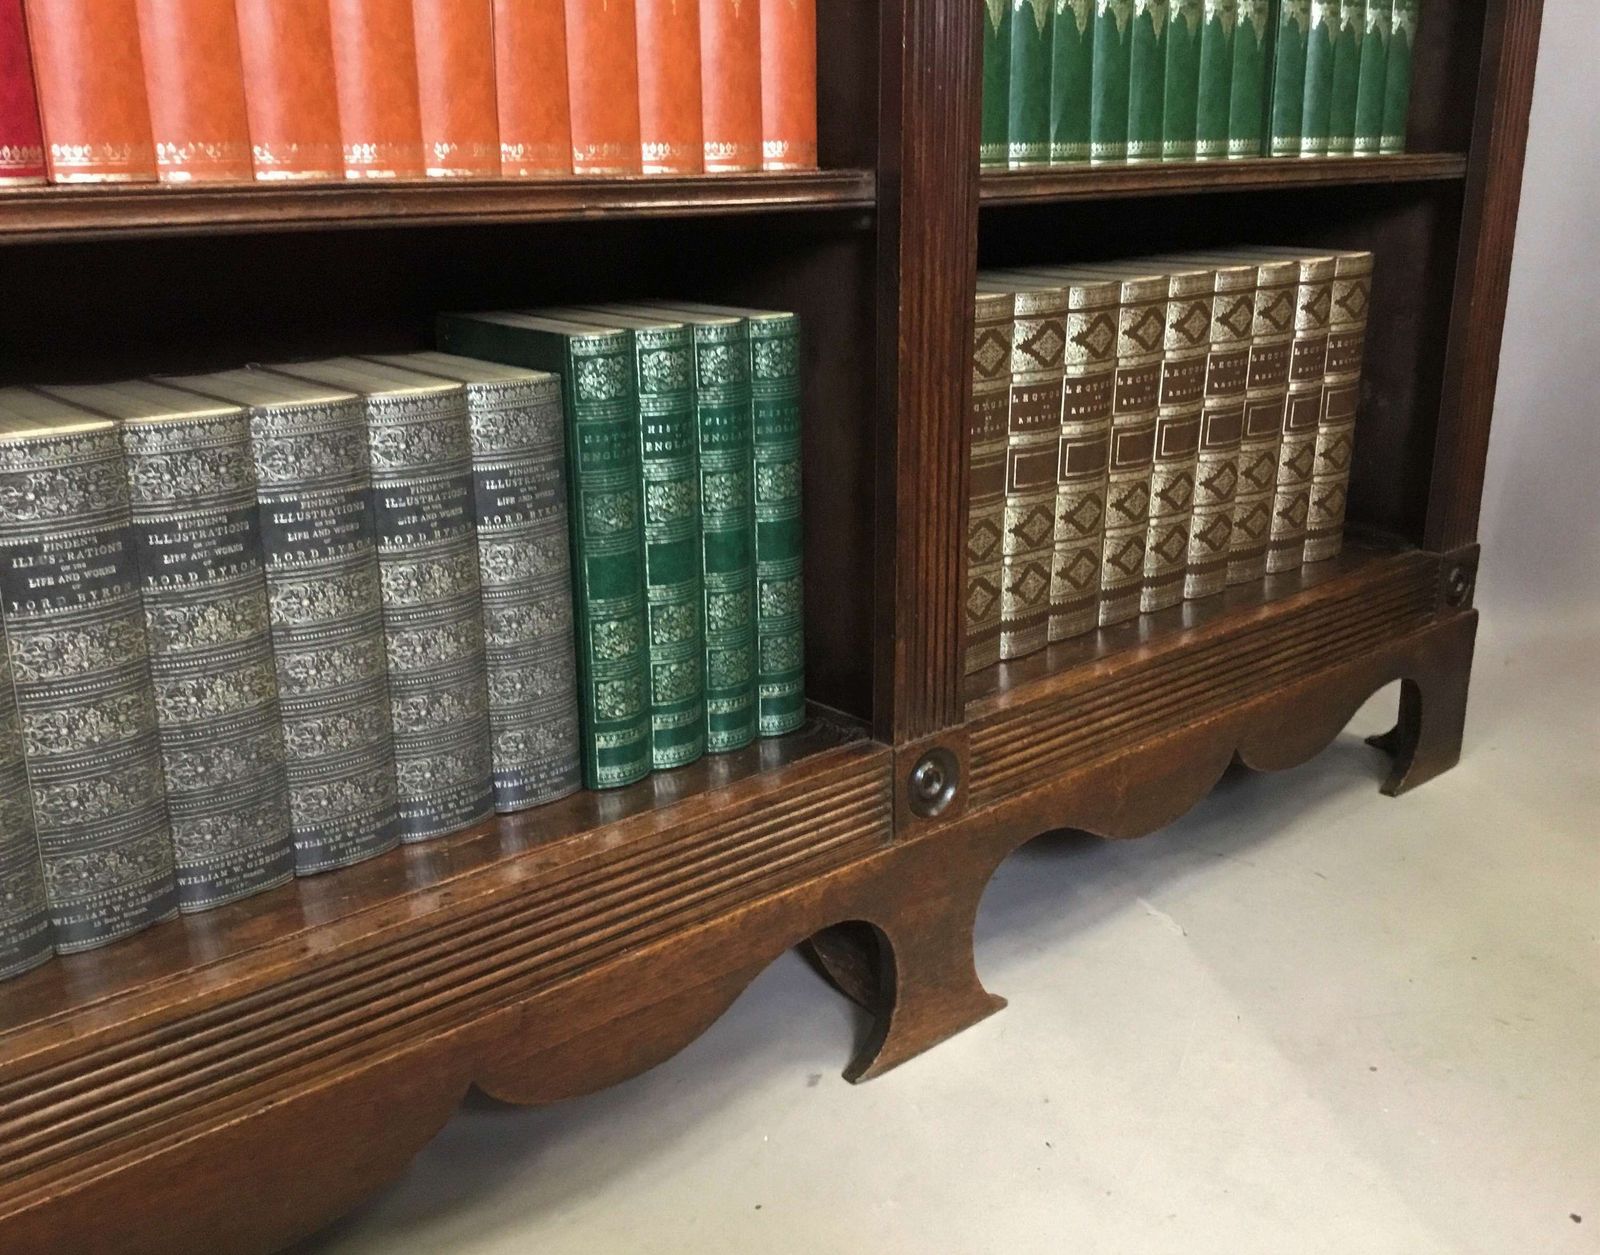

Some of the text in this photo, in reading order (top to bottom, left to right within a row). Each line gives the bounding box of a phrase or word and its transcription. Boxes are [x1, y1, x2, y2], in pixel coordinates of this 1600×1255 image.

[274, 501, 365, 524] ILLUSTRATIONS
[484, 512, 522, 525] LORD
[148, 521, 249, 545] ILLUSTRATIONS
[384, 533, 426, 545] LORD
[272, 549, 319, 564] LORD
[148, 572, 198, 587] LORD
[12, 596, 66, 611] LORD
